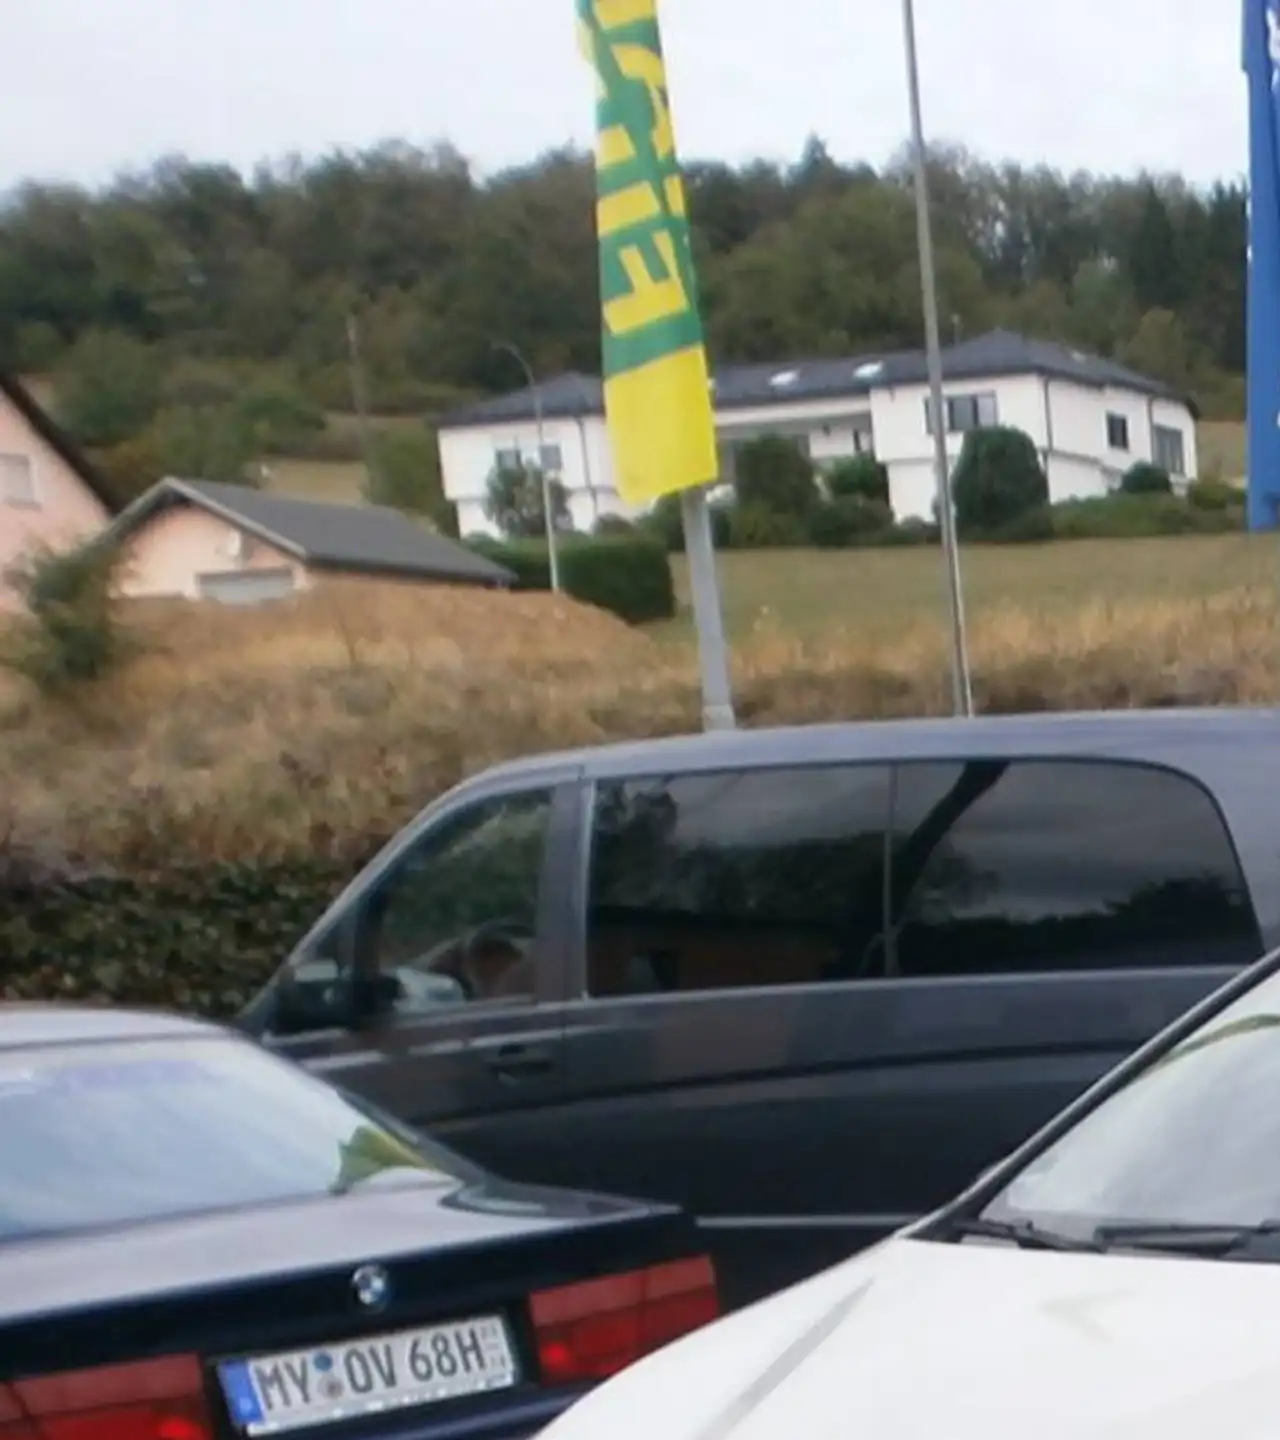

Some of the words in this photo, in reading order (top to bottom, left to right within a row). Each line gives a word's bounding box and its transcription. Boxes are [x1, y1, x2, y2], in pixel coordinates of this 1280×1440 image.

[254, 1359, 311, 1411] MY
[343, 1345, 397, 1394] OV
[408, 1328, 486, 1382] 68H
